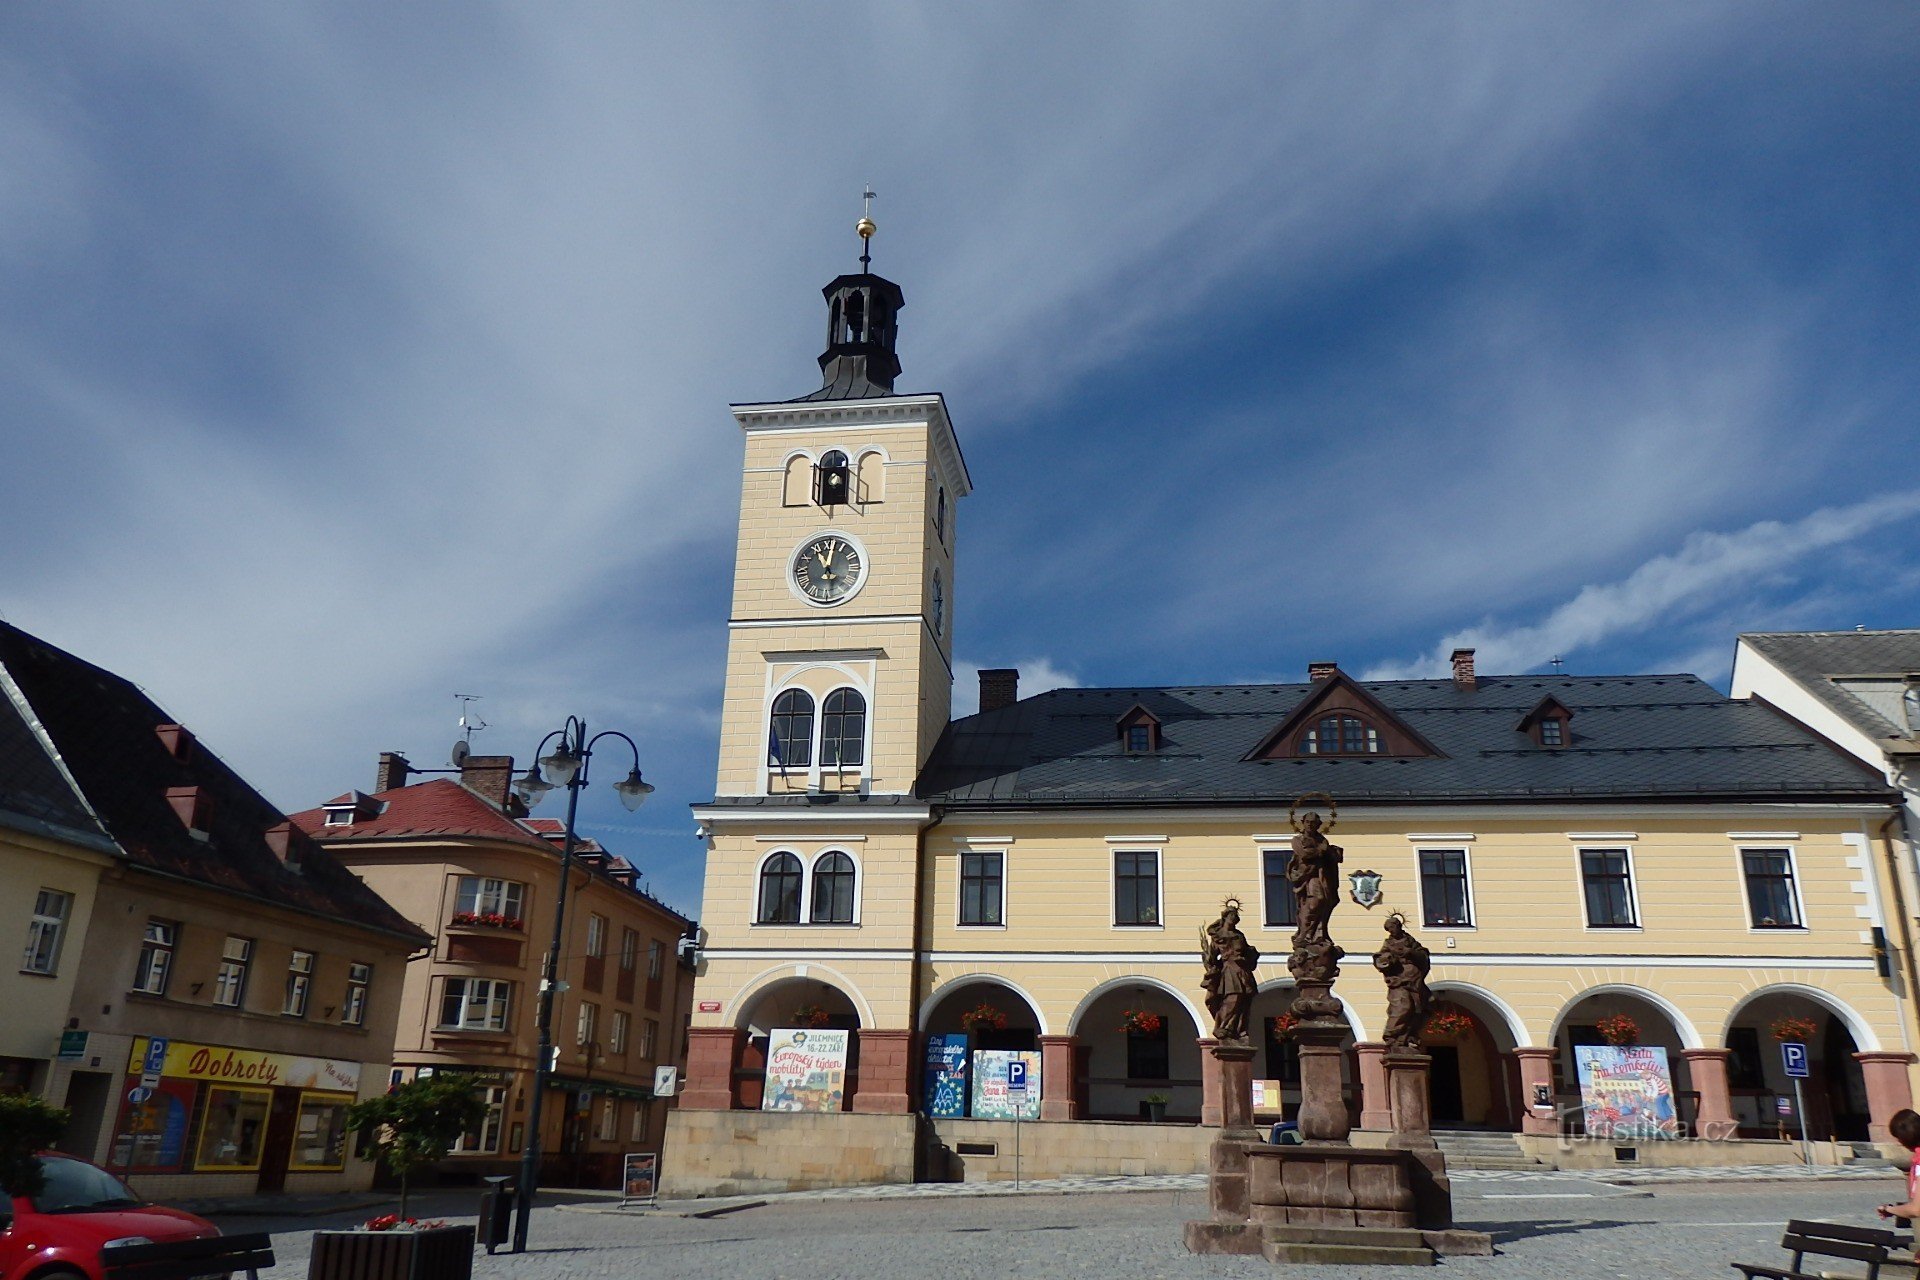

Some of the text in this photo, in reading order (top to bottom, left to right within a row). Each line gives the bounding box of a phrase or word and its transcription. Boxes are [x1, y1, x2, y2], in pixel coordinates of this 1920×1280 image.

[801, 554, 811, 562] X
[808, 1034, 844, 1042] JILEMNICE
[150, 1041, 162, 1060] P
[1787, 1047, 1802, 1066] P
[189, 1048, 278, 1084] Dobroty
[770, 1063, 806, 1077] mobility
[774, 1052, 842, 1071] Evropský týden
[1011, 1064, 1023, 1082] P
